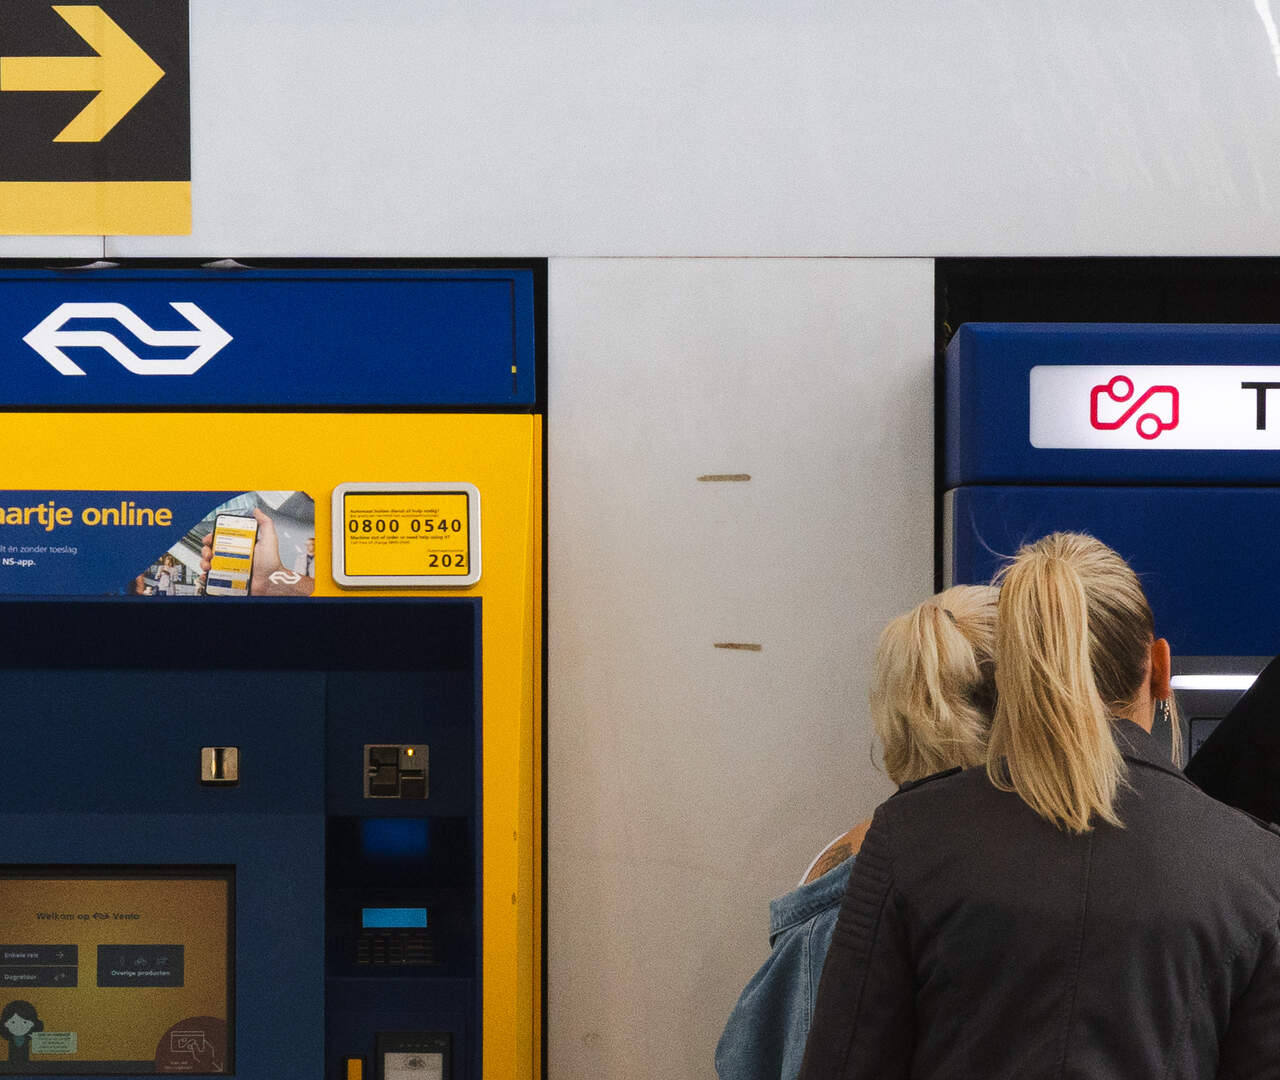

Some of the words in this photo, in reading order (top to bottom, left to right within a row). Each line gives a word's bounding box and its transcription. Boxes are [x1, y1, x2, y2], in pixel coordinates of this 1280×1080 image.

[81, 501, 172, 526] online
[349, 519, 399, 533] 0800
[411, 519, 461, 533] 0540
[20, 545, 47, 553] zonder
[2, 557, 36, 567] NS-app.
[429, 554, 465, 567] 202
